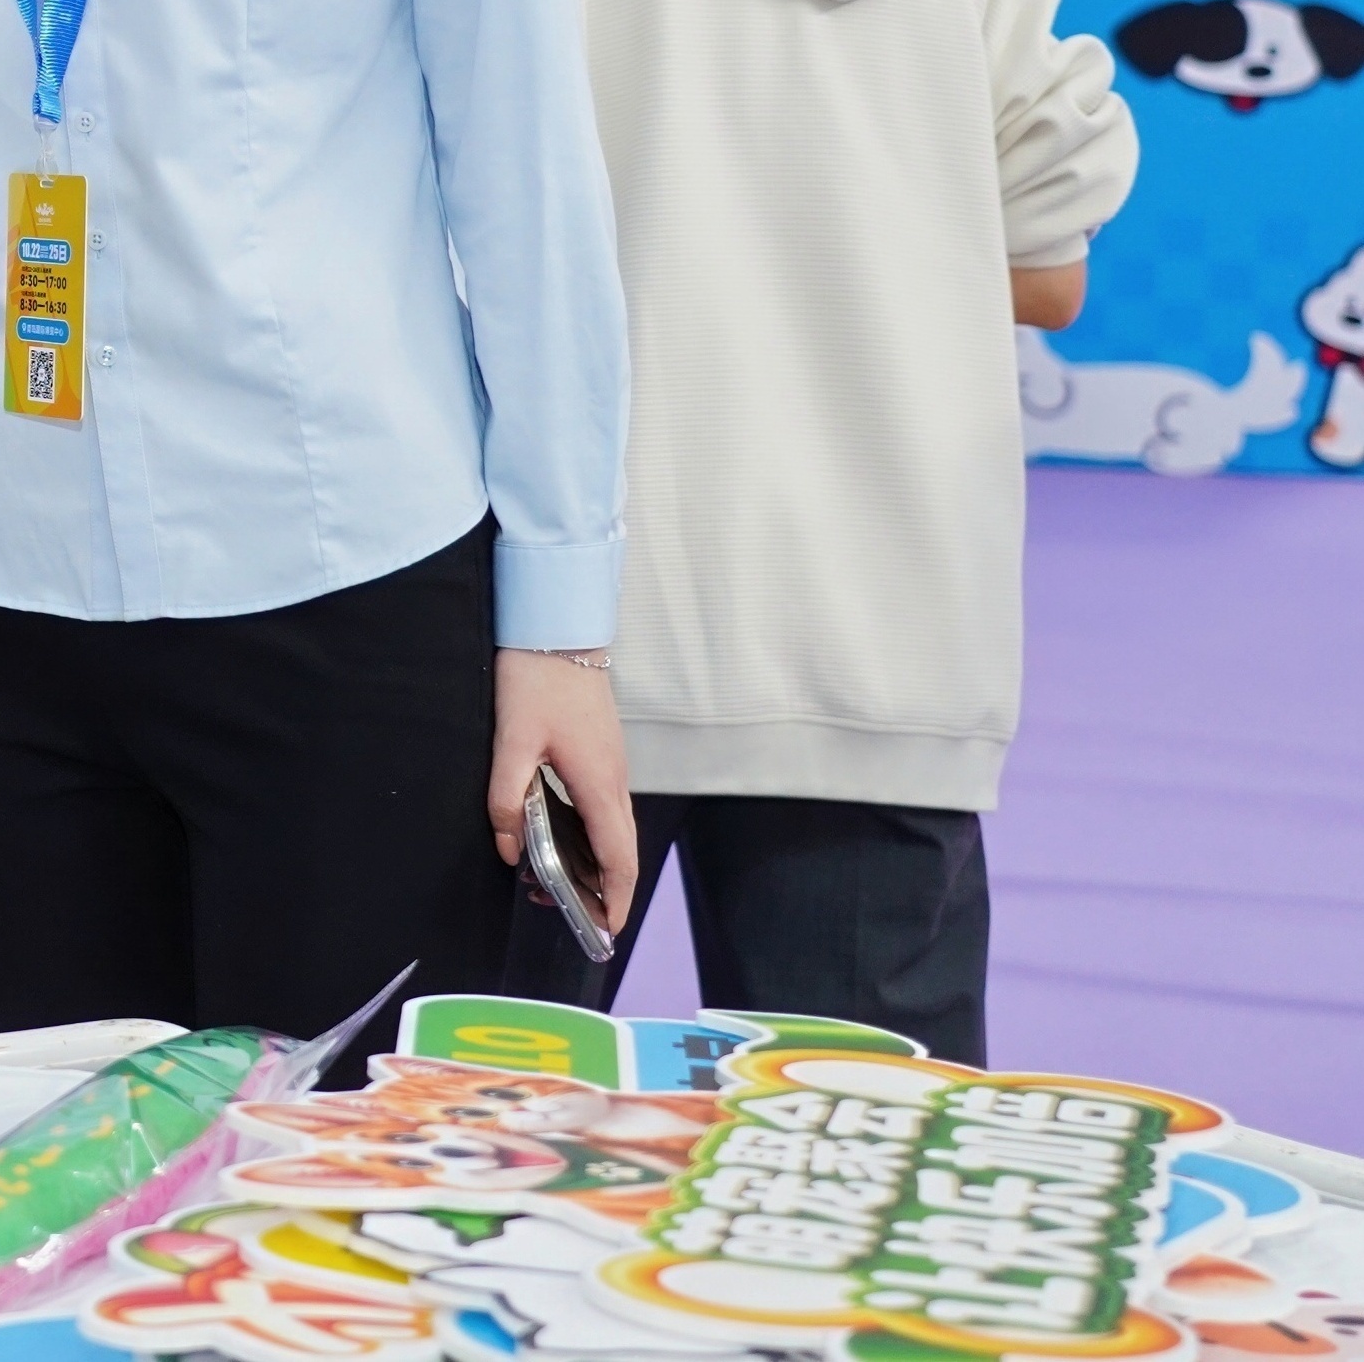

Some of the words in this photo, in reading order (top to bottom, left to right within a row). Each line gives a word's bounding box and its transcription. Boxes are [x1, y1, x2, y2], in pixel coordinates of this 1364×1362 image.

[663, 1090, 932, 1270] 萌宠聚会
[864, 1085, 1141, 1334] 让快乐加倍
